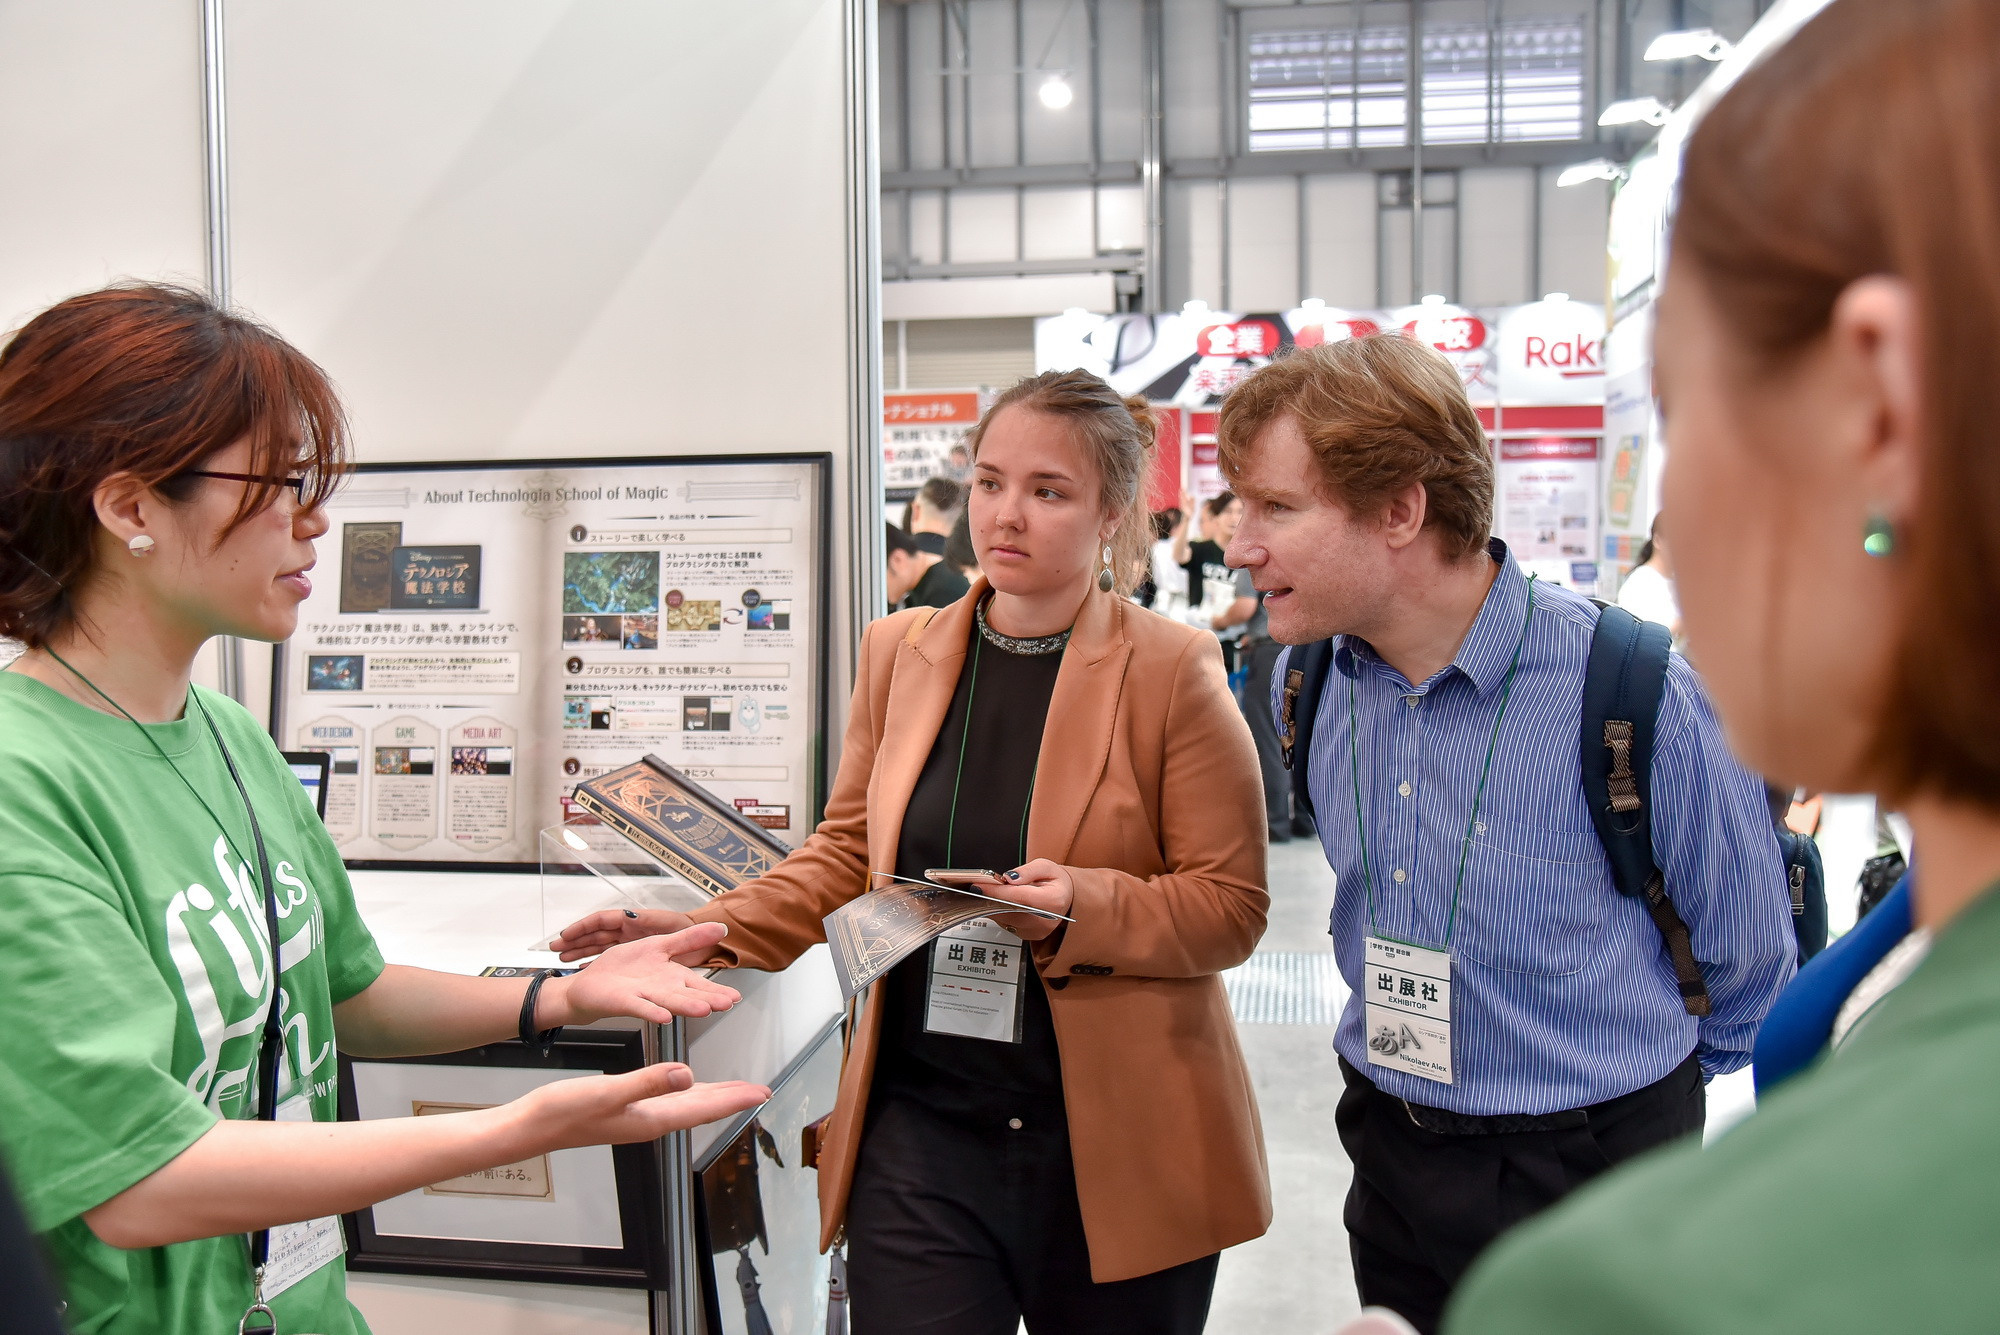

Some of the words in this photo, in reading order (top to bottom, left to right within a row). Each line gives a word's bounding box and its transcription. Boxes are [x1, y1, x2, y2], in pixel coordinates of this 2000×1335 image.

[1208, 325, 1264, 354] 企業
[1525, 333, 1603, 367] Rak
[424, 490, 463, 504] About
[468, 488, 550, 504] Technologia
[556, 487, 602, 502] School
[607, 487, 620, 500] of
[625, 487, 669, 502] Magic
[590, 533, 686, 543] ストーリーで楽しく学べる
[666, 552, 763, 560] ストーリーの中で起こる問題を
[666, 561, 749, 569] プログラミングの力で解決
[405, 581, 466, 595] 魔法学校
[571, 662, 579, 673] 2
[312, 727, 328, 738] WEB
[329, 727, 354, 738] DESIGN
[395, 727, 416, 739] GAME
[462, 728, 487, 739] MEDIA
[488, 727, 502, 739] ART
[568, 763, 577, 773] 3
[948, 943, 1009, 968] 出展社
[957, 964, 996, 976] EXHIBITOR
[1378, 972, 1438, 1003] 出展社
[1388, 995, 1427, 1011] EXHIBITOR
[1399, 1053, 1430, 1067] Nikolaev
[1431, 1062, 1447, 1072] Alex
